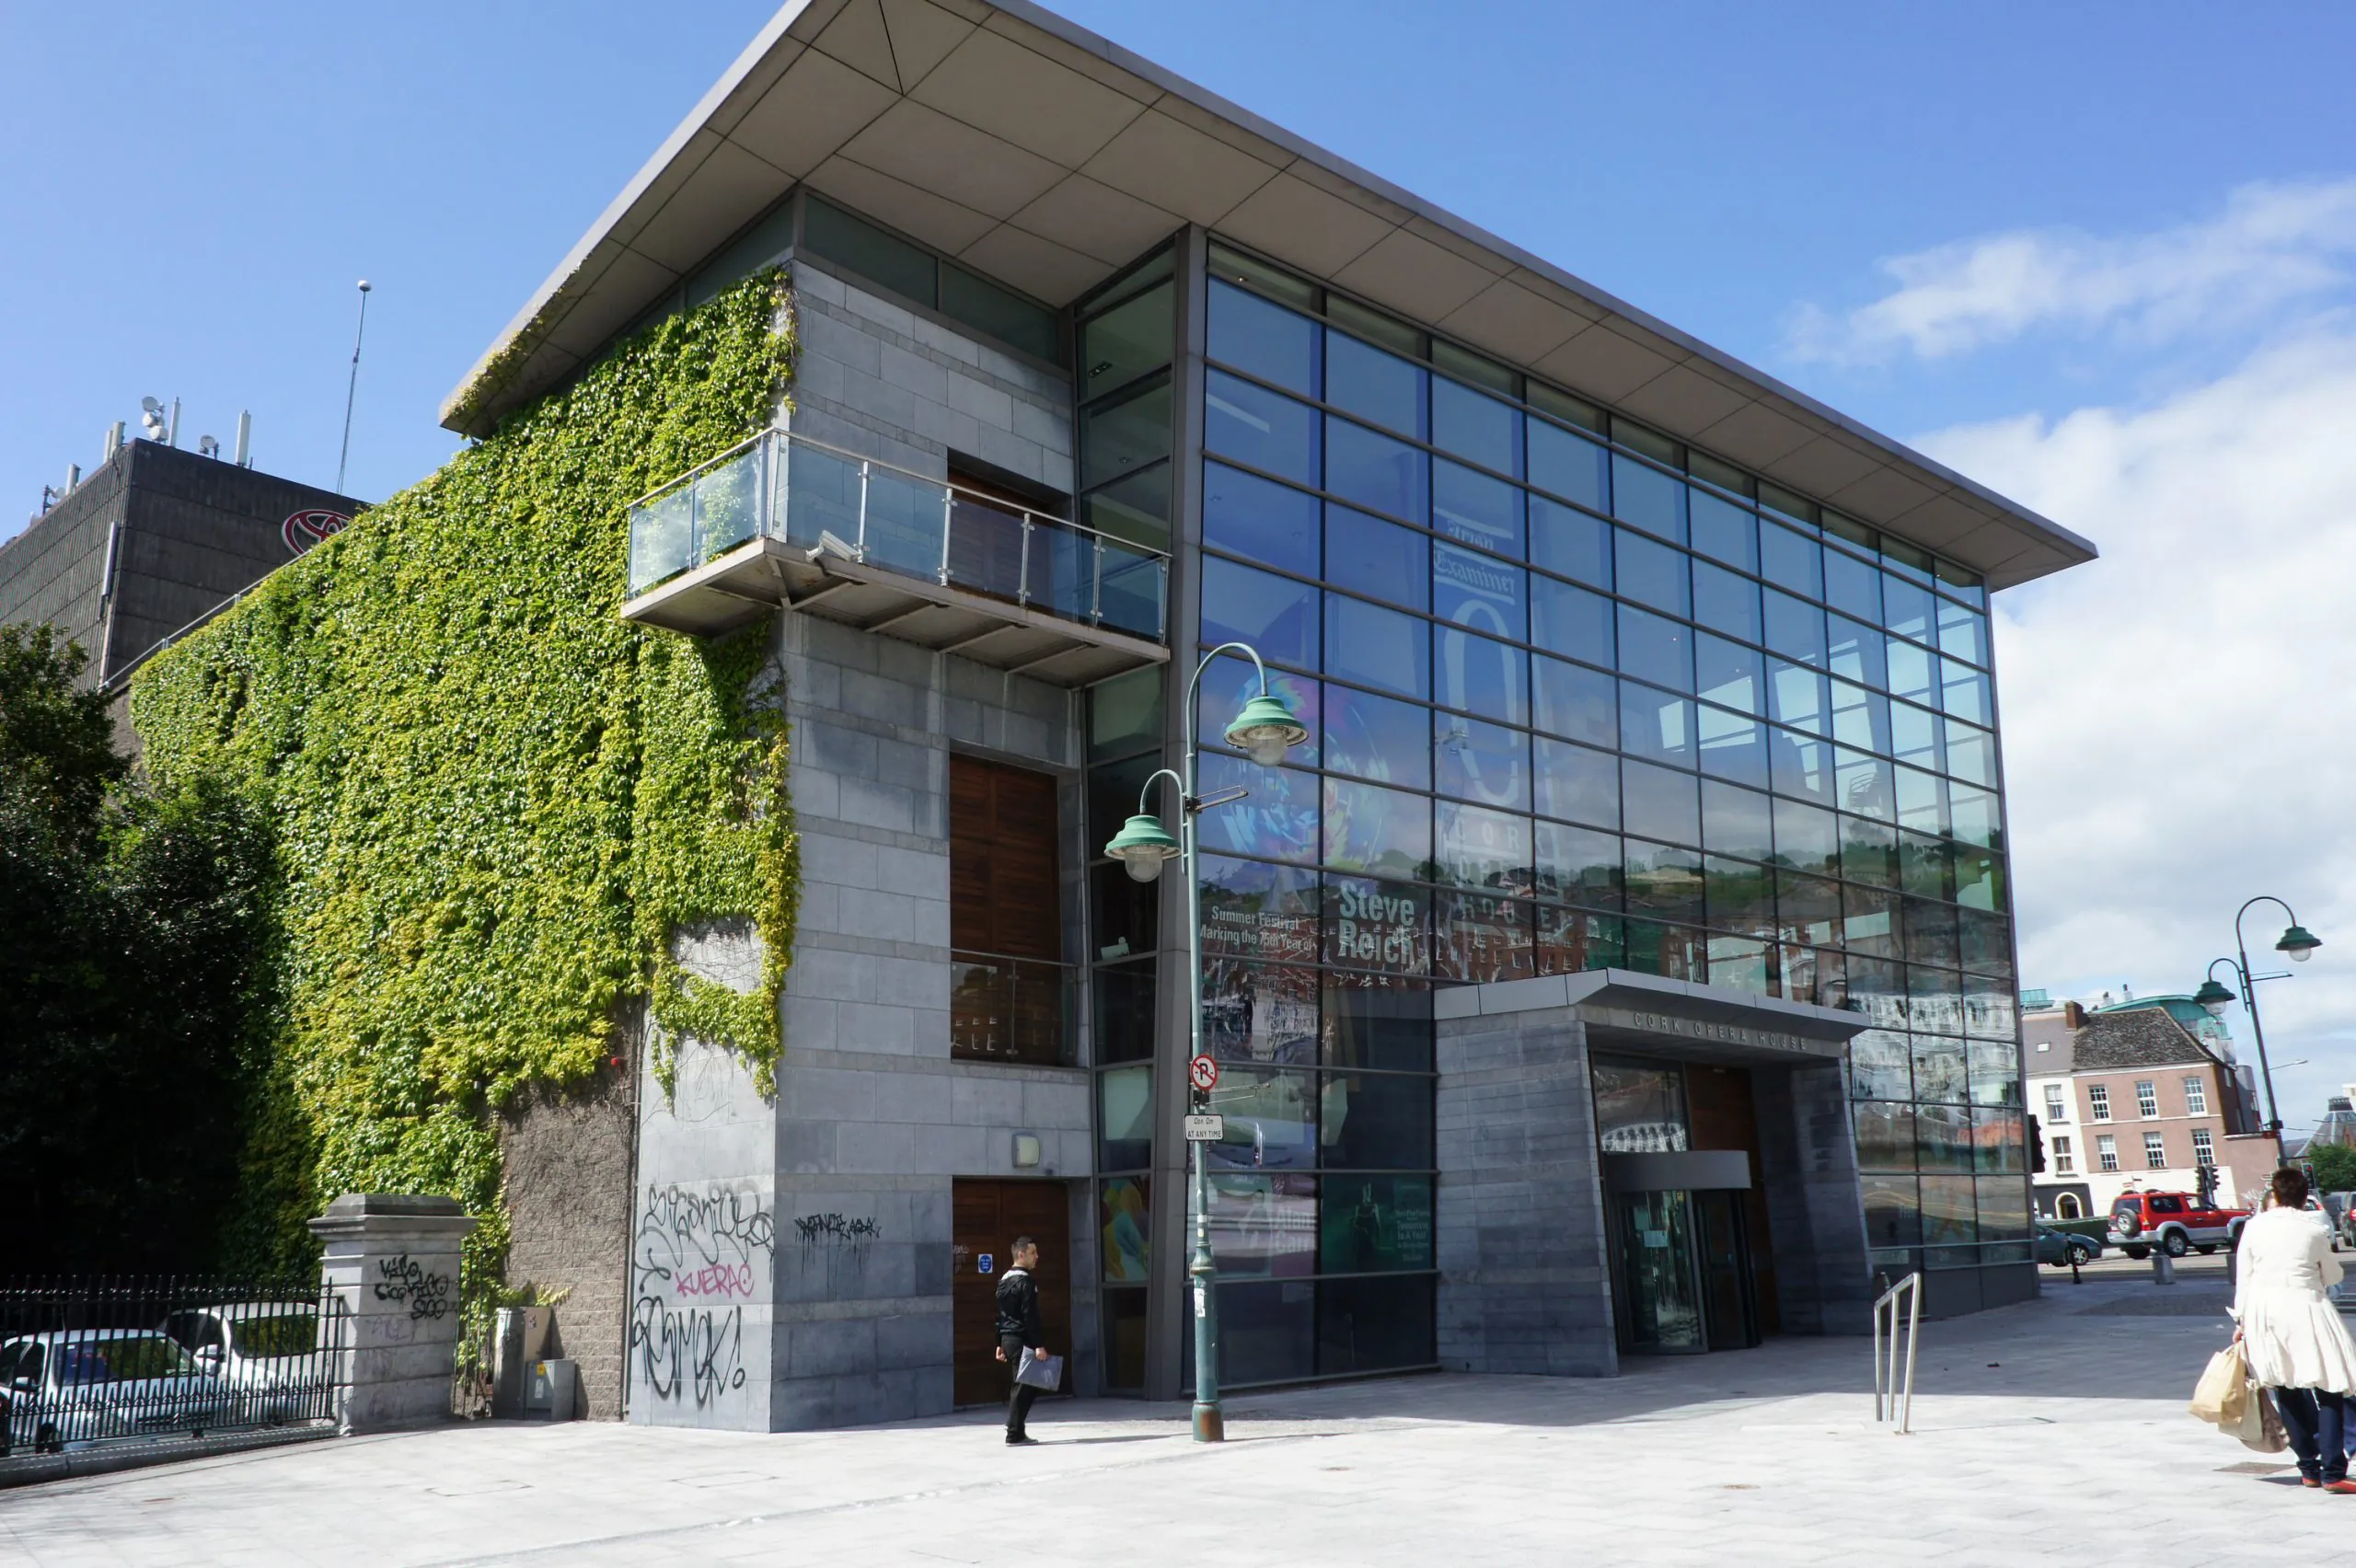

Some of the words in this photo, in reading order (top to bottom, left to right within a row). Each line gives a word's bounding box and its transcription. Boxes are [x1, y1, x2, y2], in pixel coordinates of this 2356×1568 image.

[1434, 549, 1516, 594] Examiner
[1211, 905, 1255, 926] Summer
[1258, 912, 1299, 930] Festival
[1339, 878, 1415, 927] Steve
[1242, 928, 1257, 944] the
[1259, 931, 1279, 947] 75th
[1279, 933, 1303, 950] Year
[1338, 918, 1415, 964] Reich
[1634, 1013, 1680, 1032] CORK
[1693, 1022, 1748, 1042] OPERA
[1758, 1032, 1807, 1051] HOUSE
[1199, 1062, 1208, 1080] P
[1187, 1130, 1195, 1138] AT
[1195, 1130, 1207, 1138] ANY
[1207, 1130, 1222, 1138] TIME
